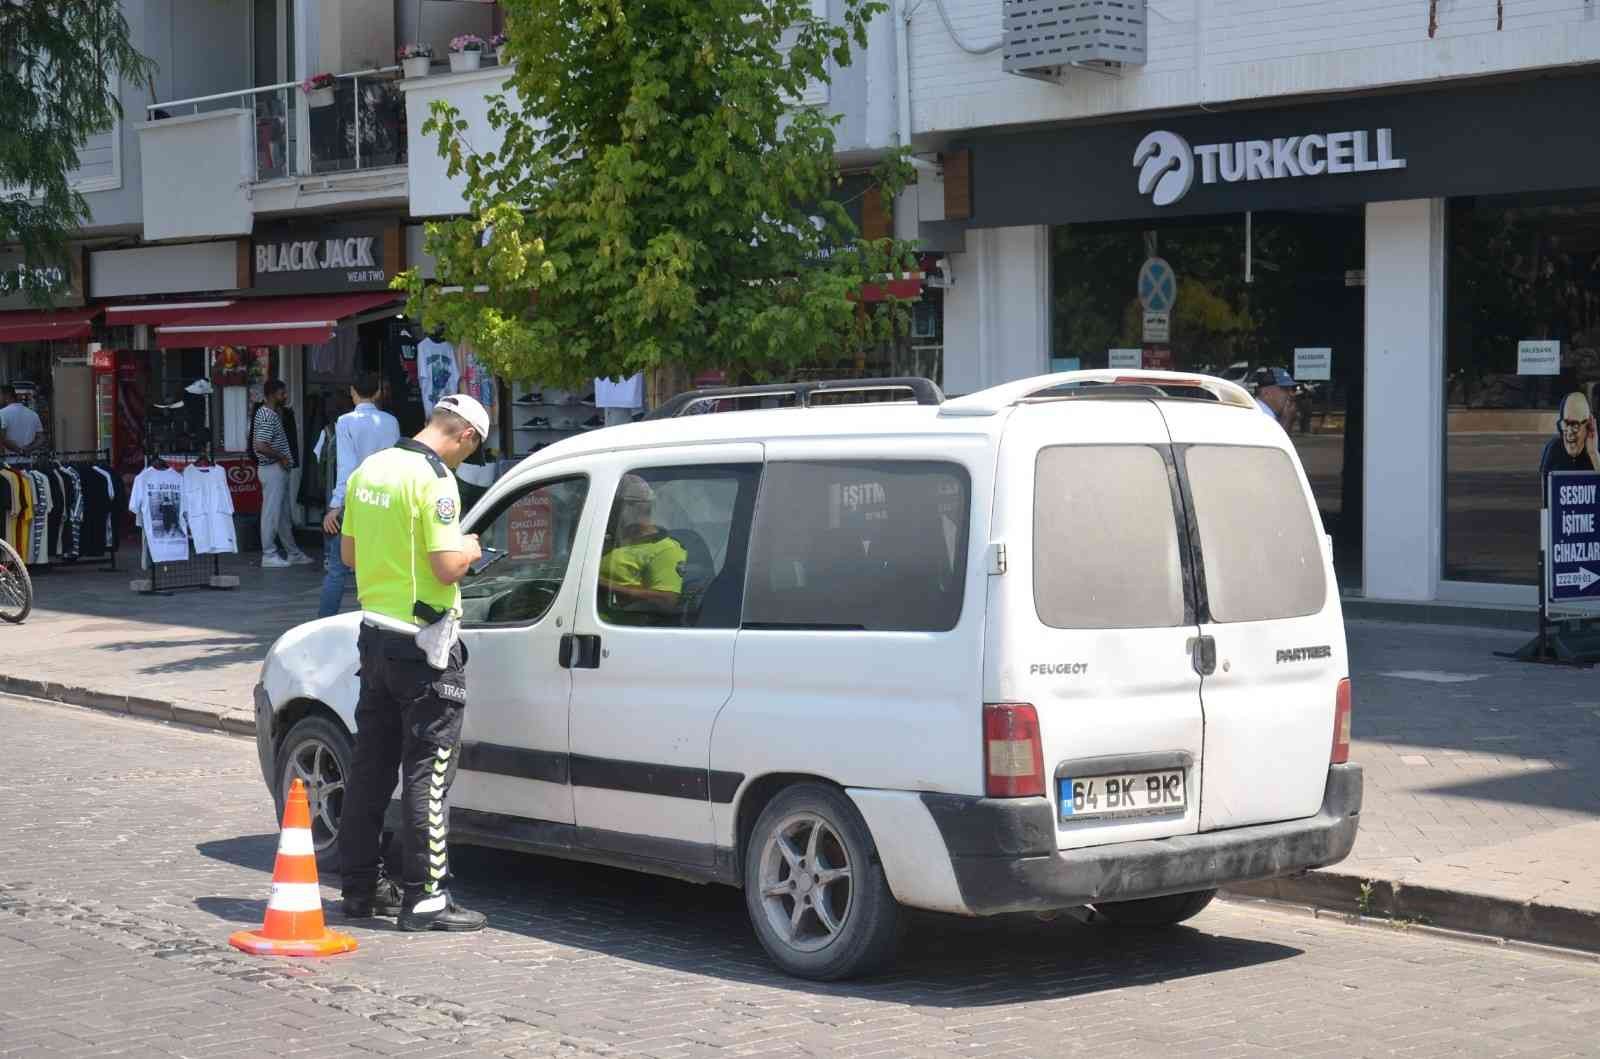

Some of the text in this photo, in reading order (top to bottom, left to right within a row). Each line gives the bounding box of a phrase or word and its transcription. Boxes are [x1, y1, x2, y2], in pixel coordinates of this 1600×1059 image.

[1193, 128, 1407, 184] TURKCELL
[256, 236, 376, 272] BLACK JACK
[368, 269, 385, 281] TWO
[1560, 484, 1596, 506] SESDUY
[1562, 510, 1595, 537] İŞİTME
[1276, 645, 1331, 664] PARTNER
[1030, 662, 1088, 675] PEUGEOT
[1073, 780, 1098, 811] 64
[1105, 778, 1136, 808] BK
